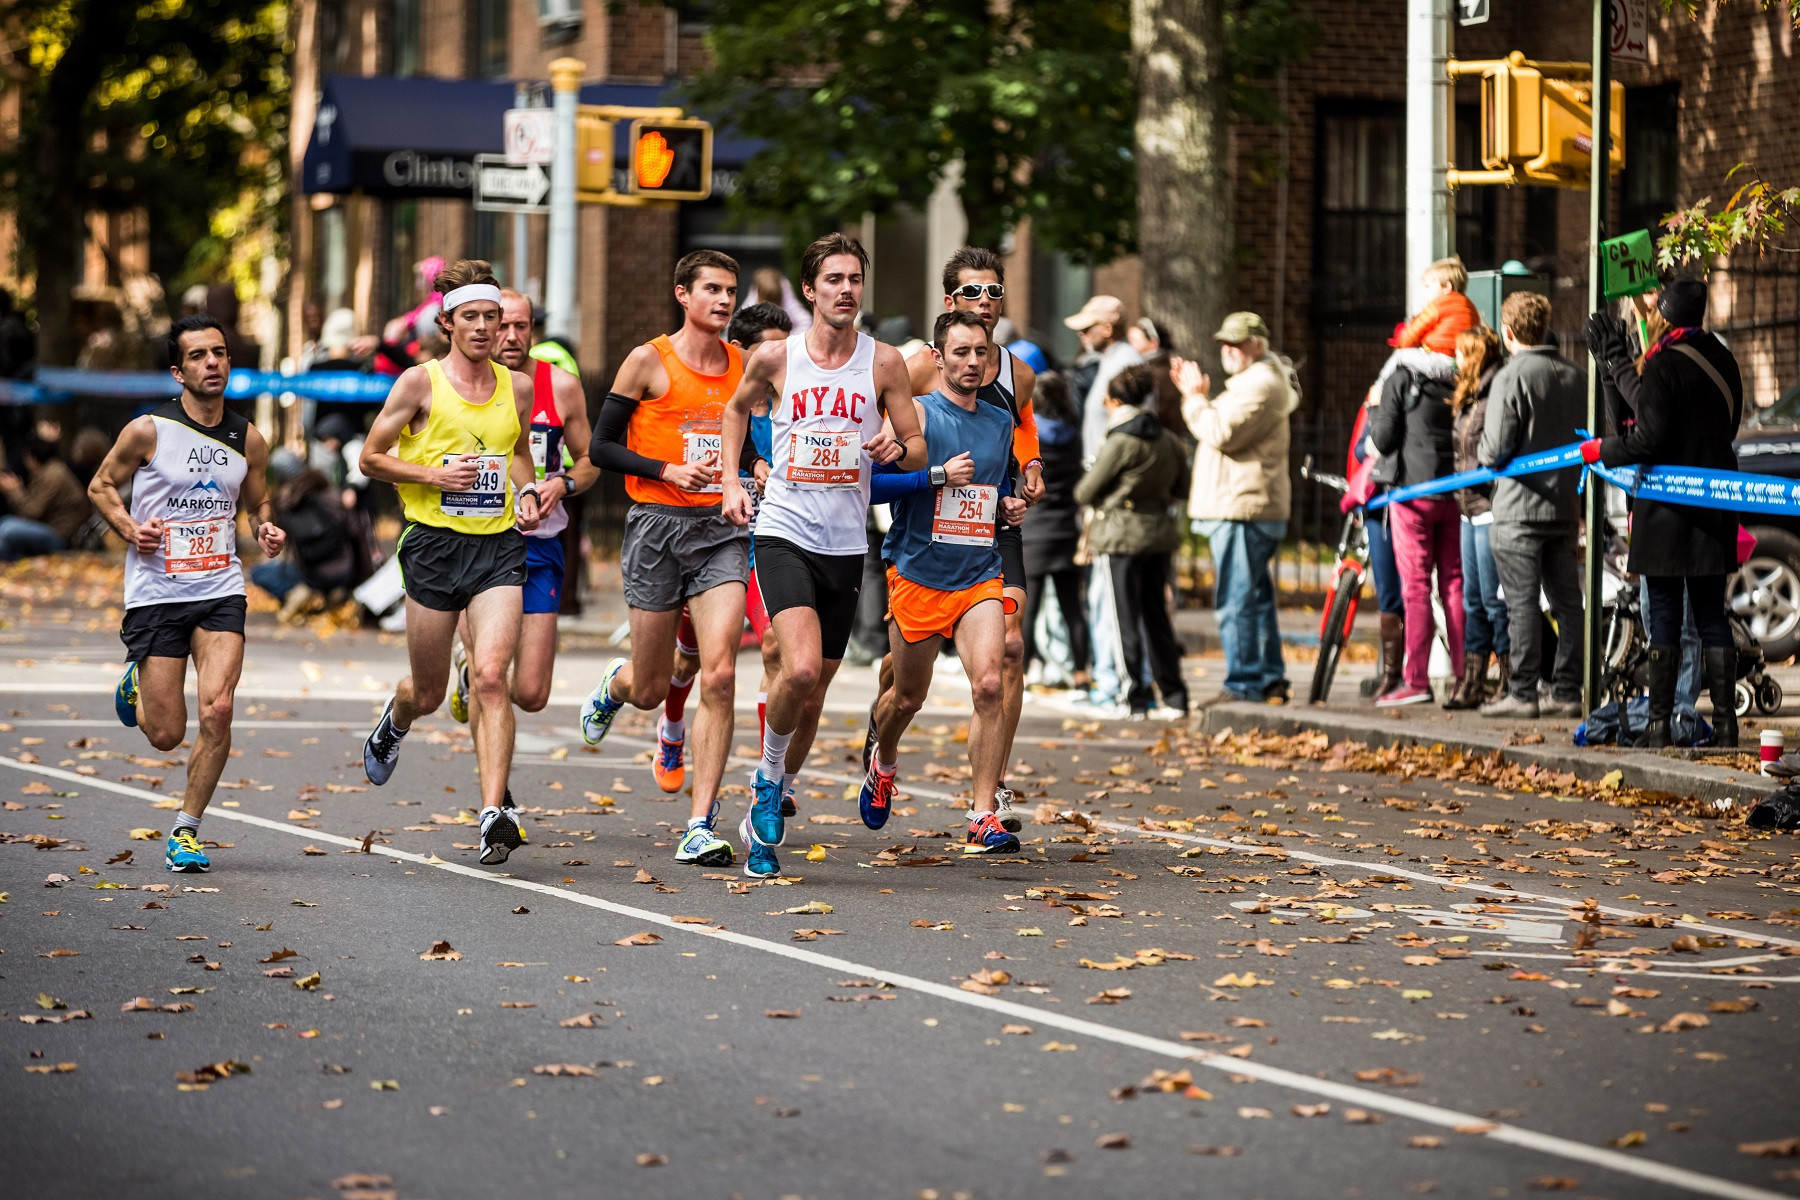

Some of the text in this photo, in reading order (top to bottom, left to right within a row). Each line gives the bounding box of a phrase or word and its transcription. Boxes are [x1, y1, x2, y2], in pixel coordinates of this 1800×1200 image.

[383, 150, 476, 189] Clinto
[1610, 242, 1629, 261] GO
[792, 387, 866, 424] NYAC
[697, 438, 720, 448] ING
[804, 436, 832, 446] ING
[187, 446, 228, 466] AÜG
[705, 450, 722, 467] 27
[812, 448, 840, 467] 284
[951, 489, 977, 499] ING
[958, 500, 982, 520] 254
[180, 526, 205, 537] ING
[189, 536, 213, 555] 282
